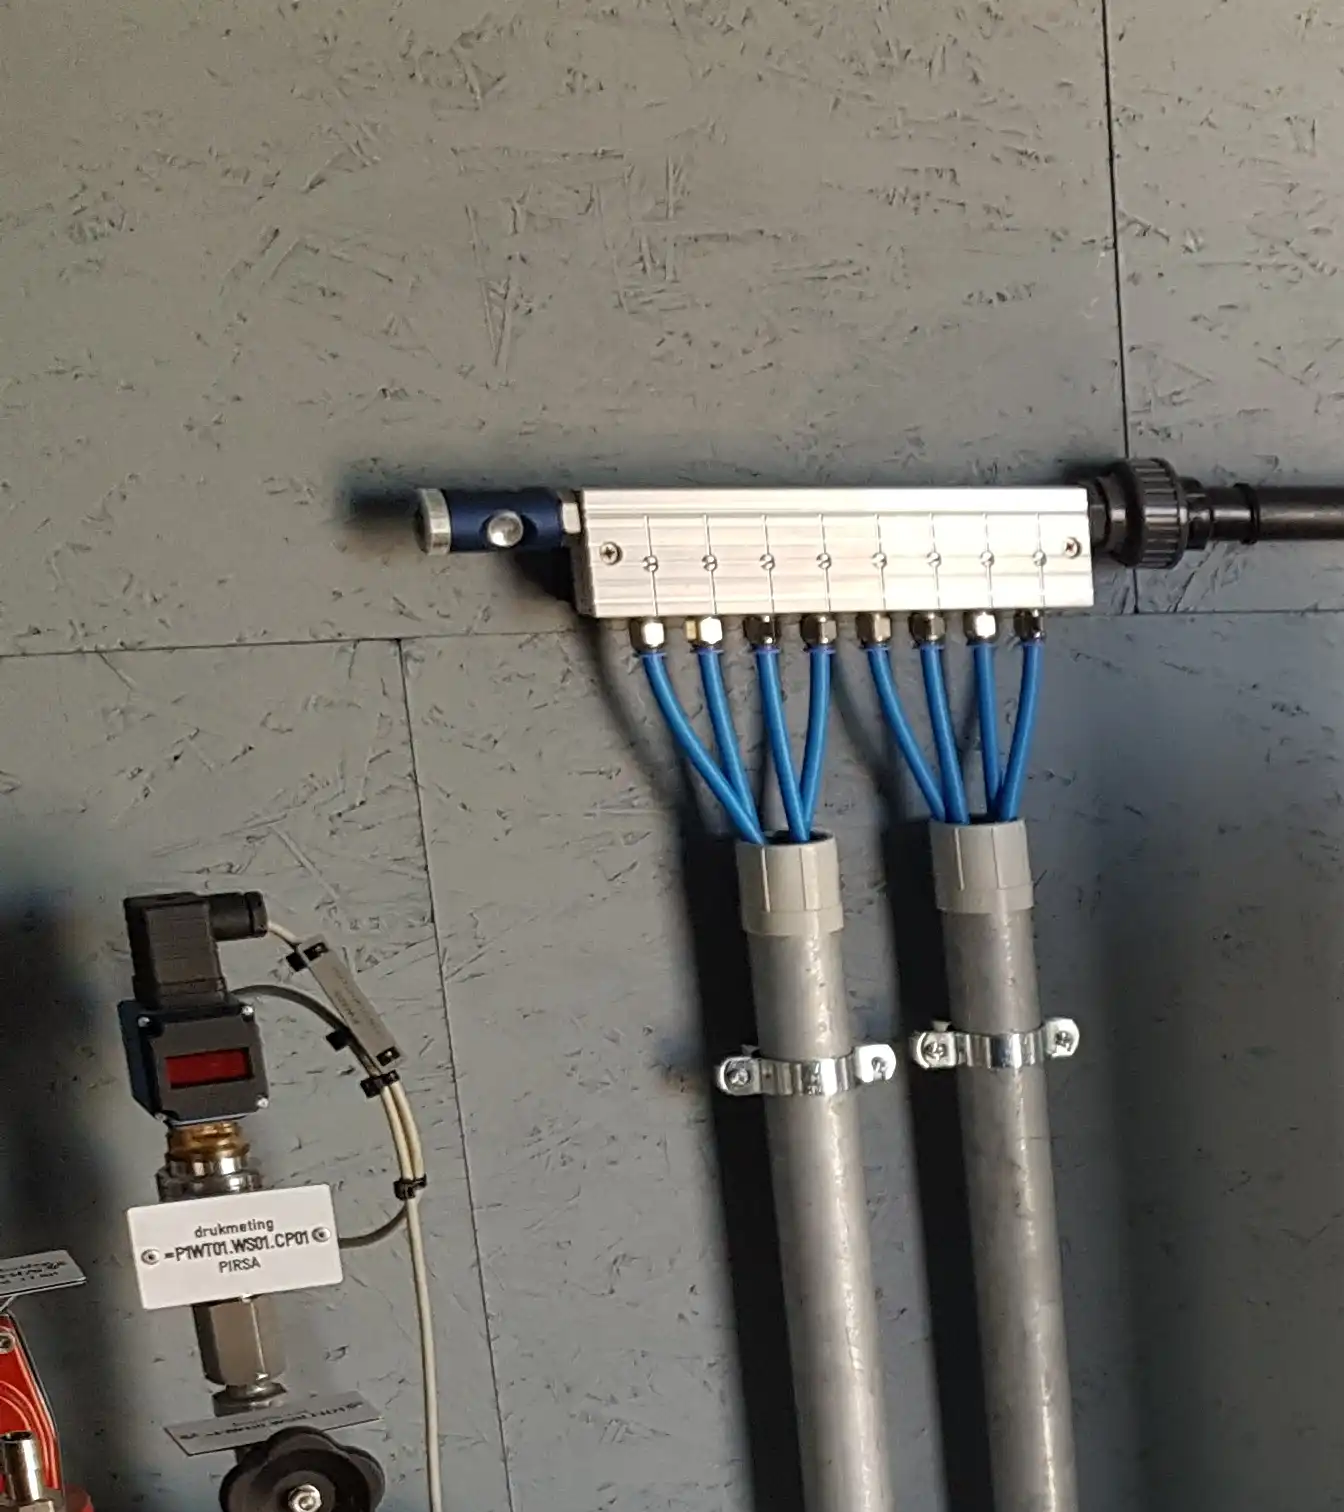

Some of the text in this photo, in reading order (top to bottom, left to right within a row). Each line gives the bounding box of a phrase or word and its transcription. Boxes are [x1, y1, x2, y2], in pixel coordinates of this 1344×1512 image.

[194, 1218, 275, 1239] drukmeting
[164, 1231, 310, 1261] =P1WT01.WS01.CP01
[219, 1256, 261, 1273] PIRSA
